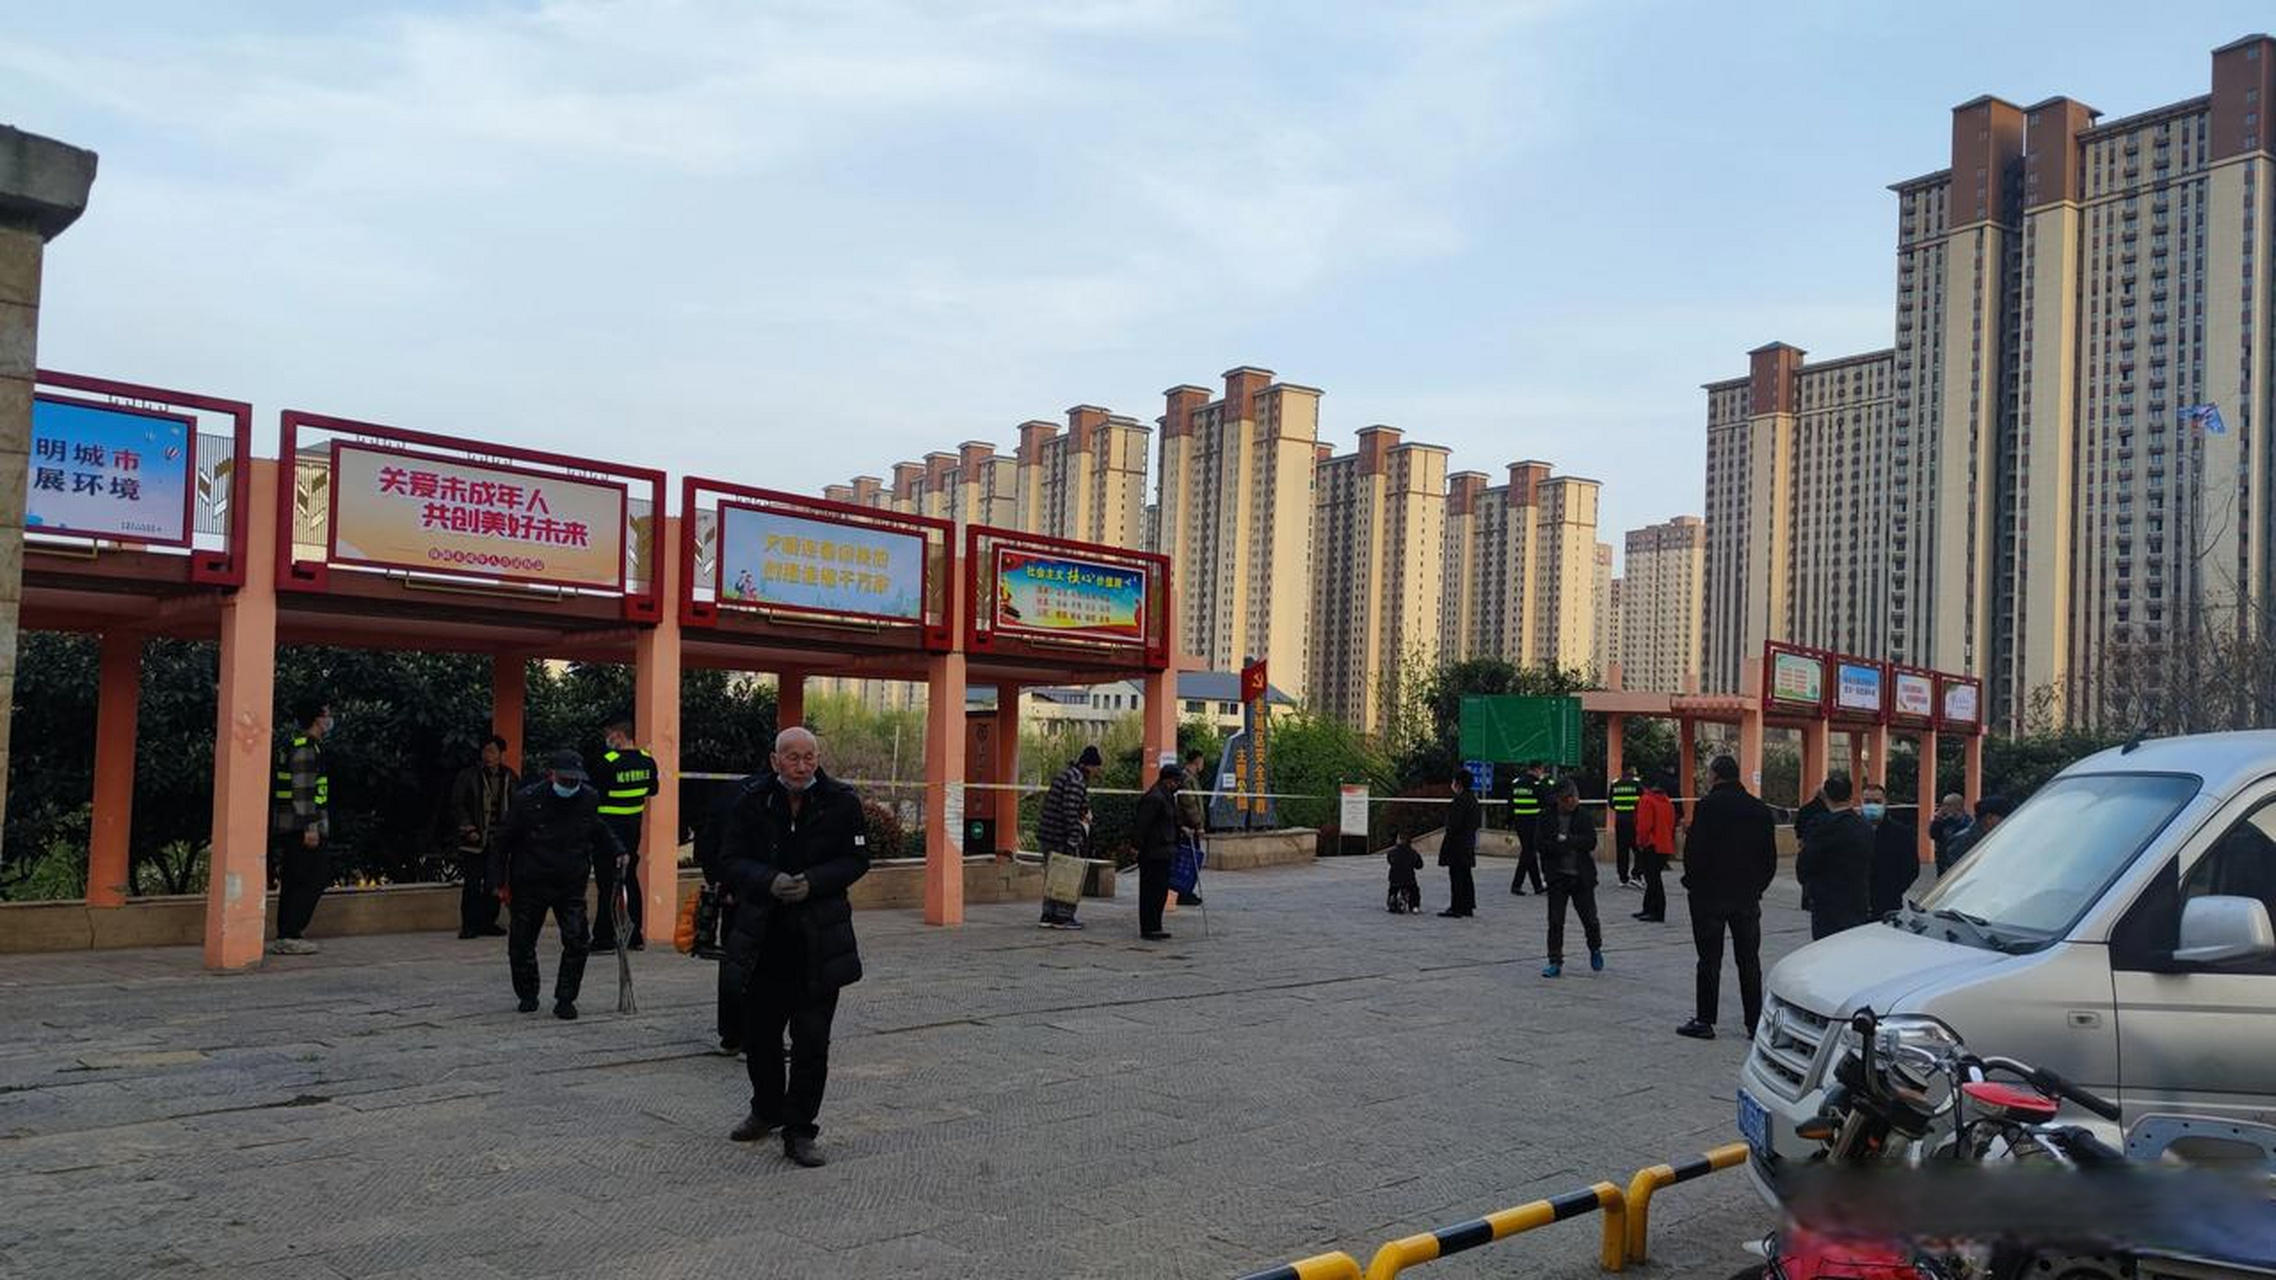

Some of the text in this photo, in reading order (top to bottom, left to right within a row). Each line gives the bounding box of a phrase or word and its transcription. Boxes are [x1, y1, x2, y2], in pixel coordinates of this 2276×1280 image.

[36, 438, 141, 471] 明城市
[33, 467, 141, 501] 展环境
[379, 467, 550, 515] 关爱未成年人
[423, 504, 589, 546] 共创美好未来
